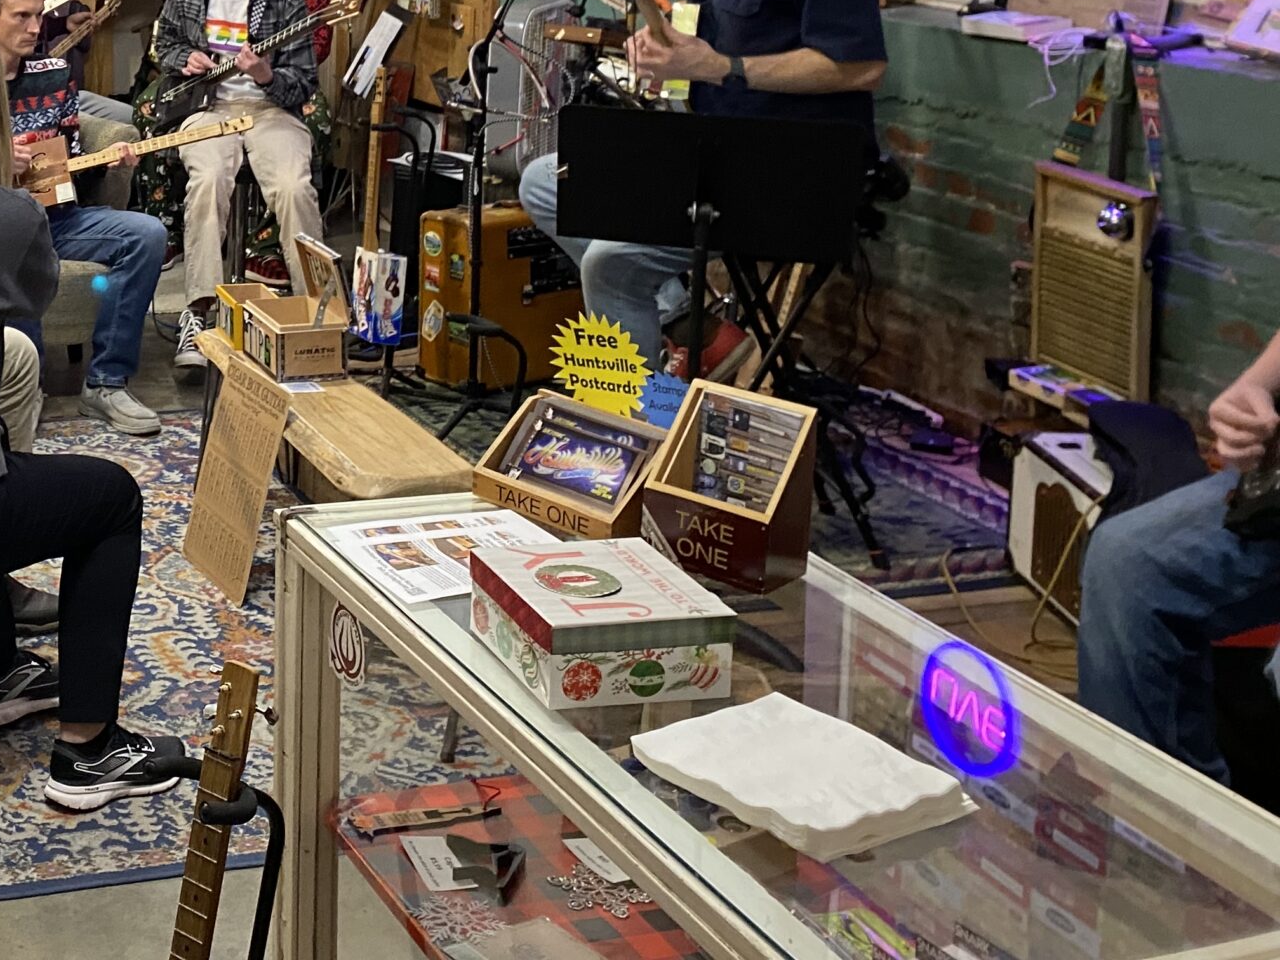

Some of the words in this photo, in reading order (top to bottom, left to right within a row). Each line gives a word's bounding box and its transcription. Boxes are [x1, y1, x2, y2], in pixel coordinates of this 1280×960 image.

[574, 328, 618, 349] Free
[563, 353, 637, 374] Huntsville
[569, 373, 637, 396] Postcards
[649, 400, 680, 413] Availa
[495, 484, 541, 516] TAKE
[546, 505, 590, 536] ONE
[675, 510, 735, 546] TAKE
[614, 545, 654, 576] WORLD
[676, 537, 730, 571] ONE
[648, 576, 670, 591] THE
